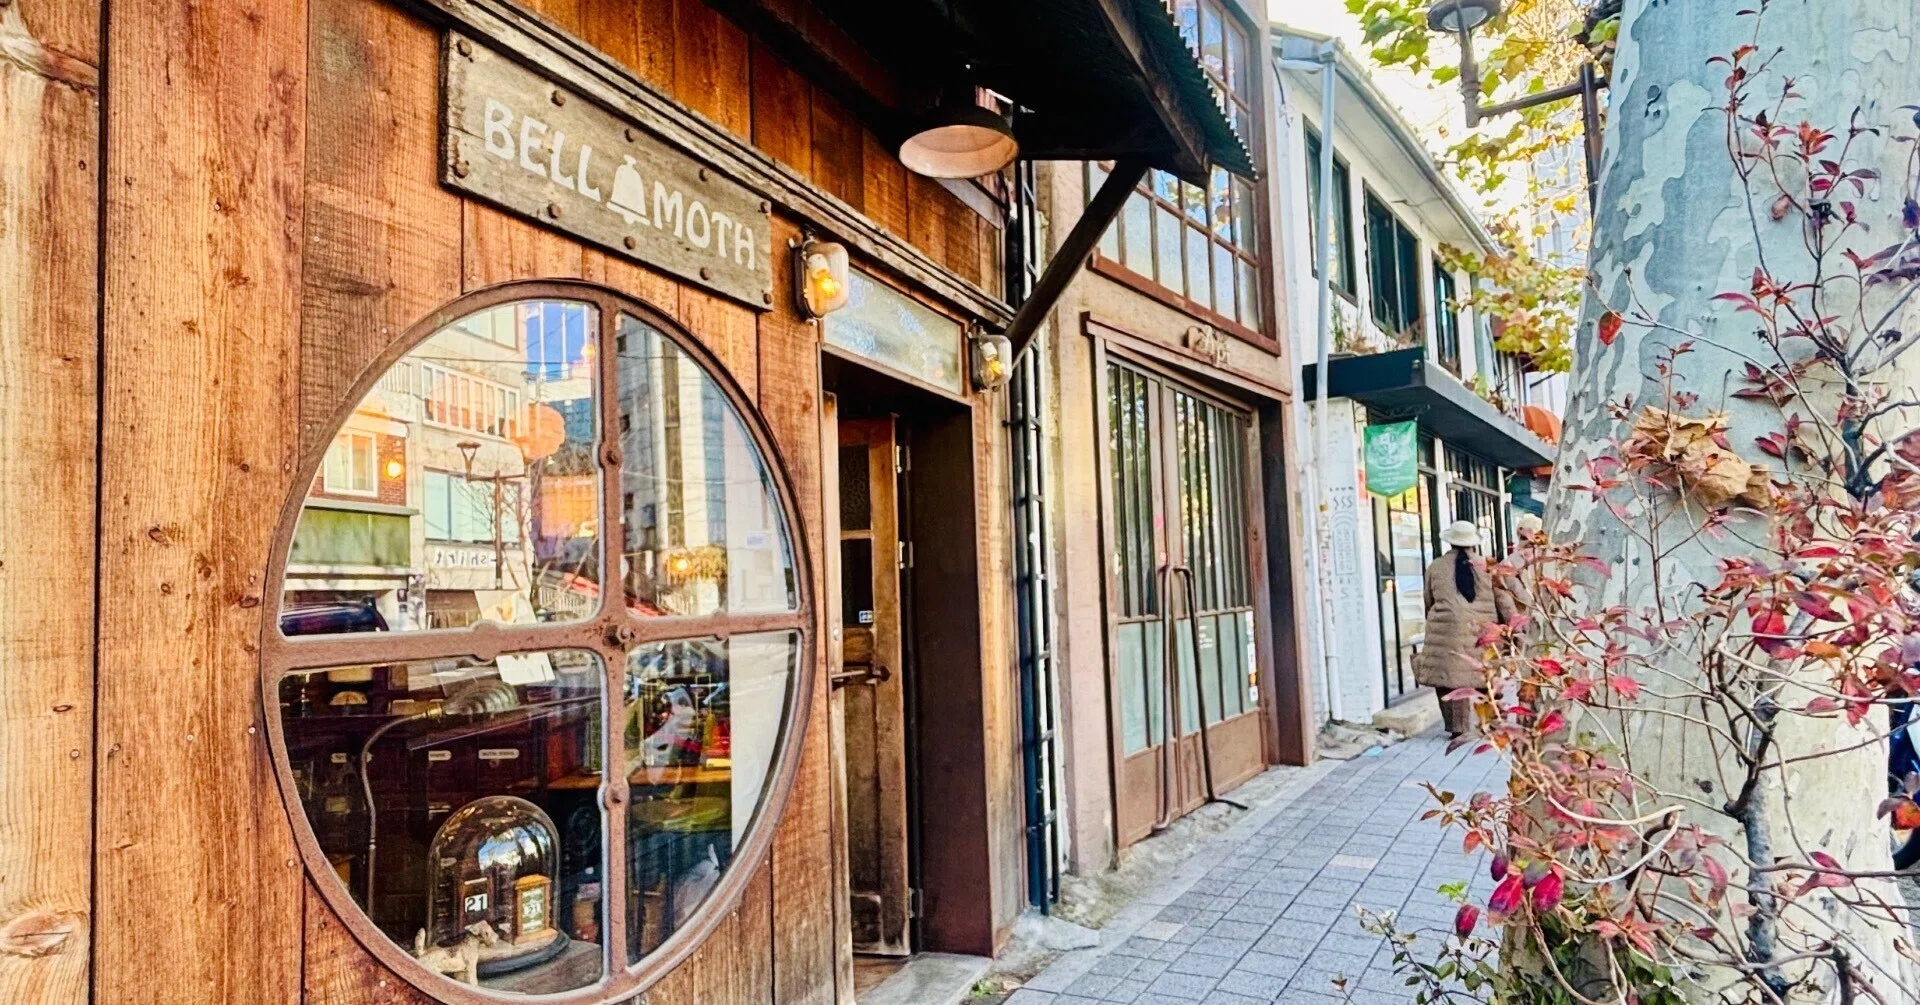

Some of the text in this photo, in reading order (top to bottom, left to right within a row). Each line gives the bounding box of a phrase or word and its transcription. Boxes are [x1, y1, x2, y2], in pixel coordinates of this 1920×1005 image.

[484, 98, 755, 270] BELL MOTH
[466, 895, 485, 912] 21
